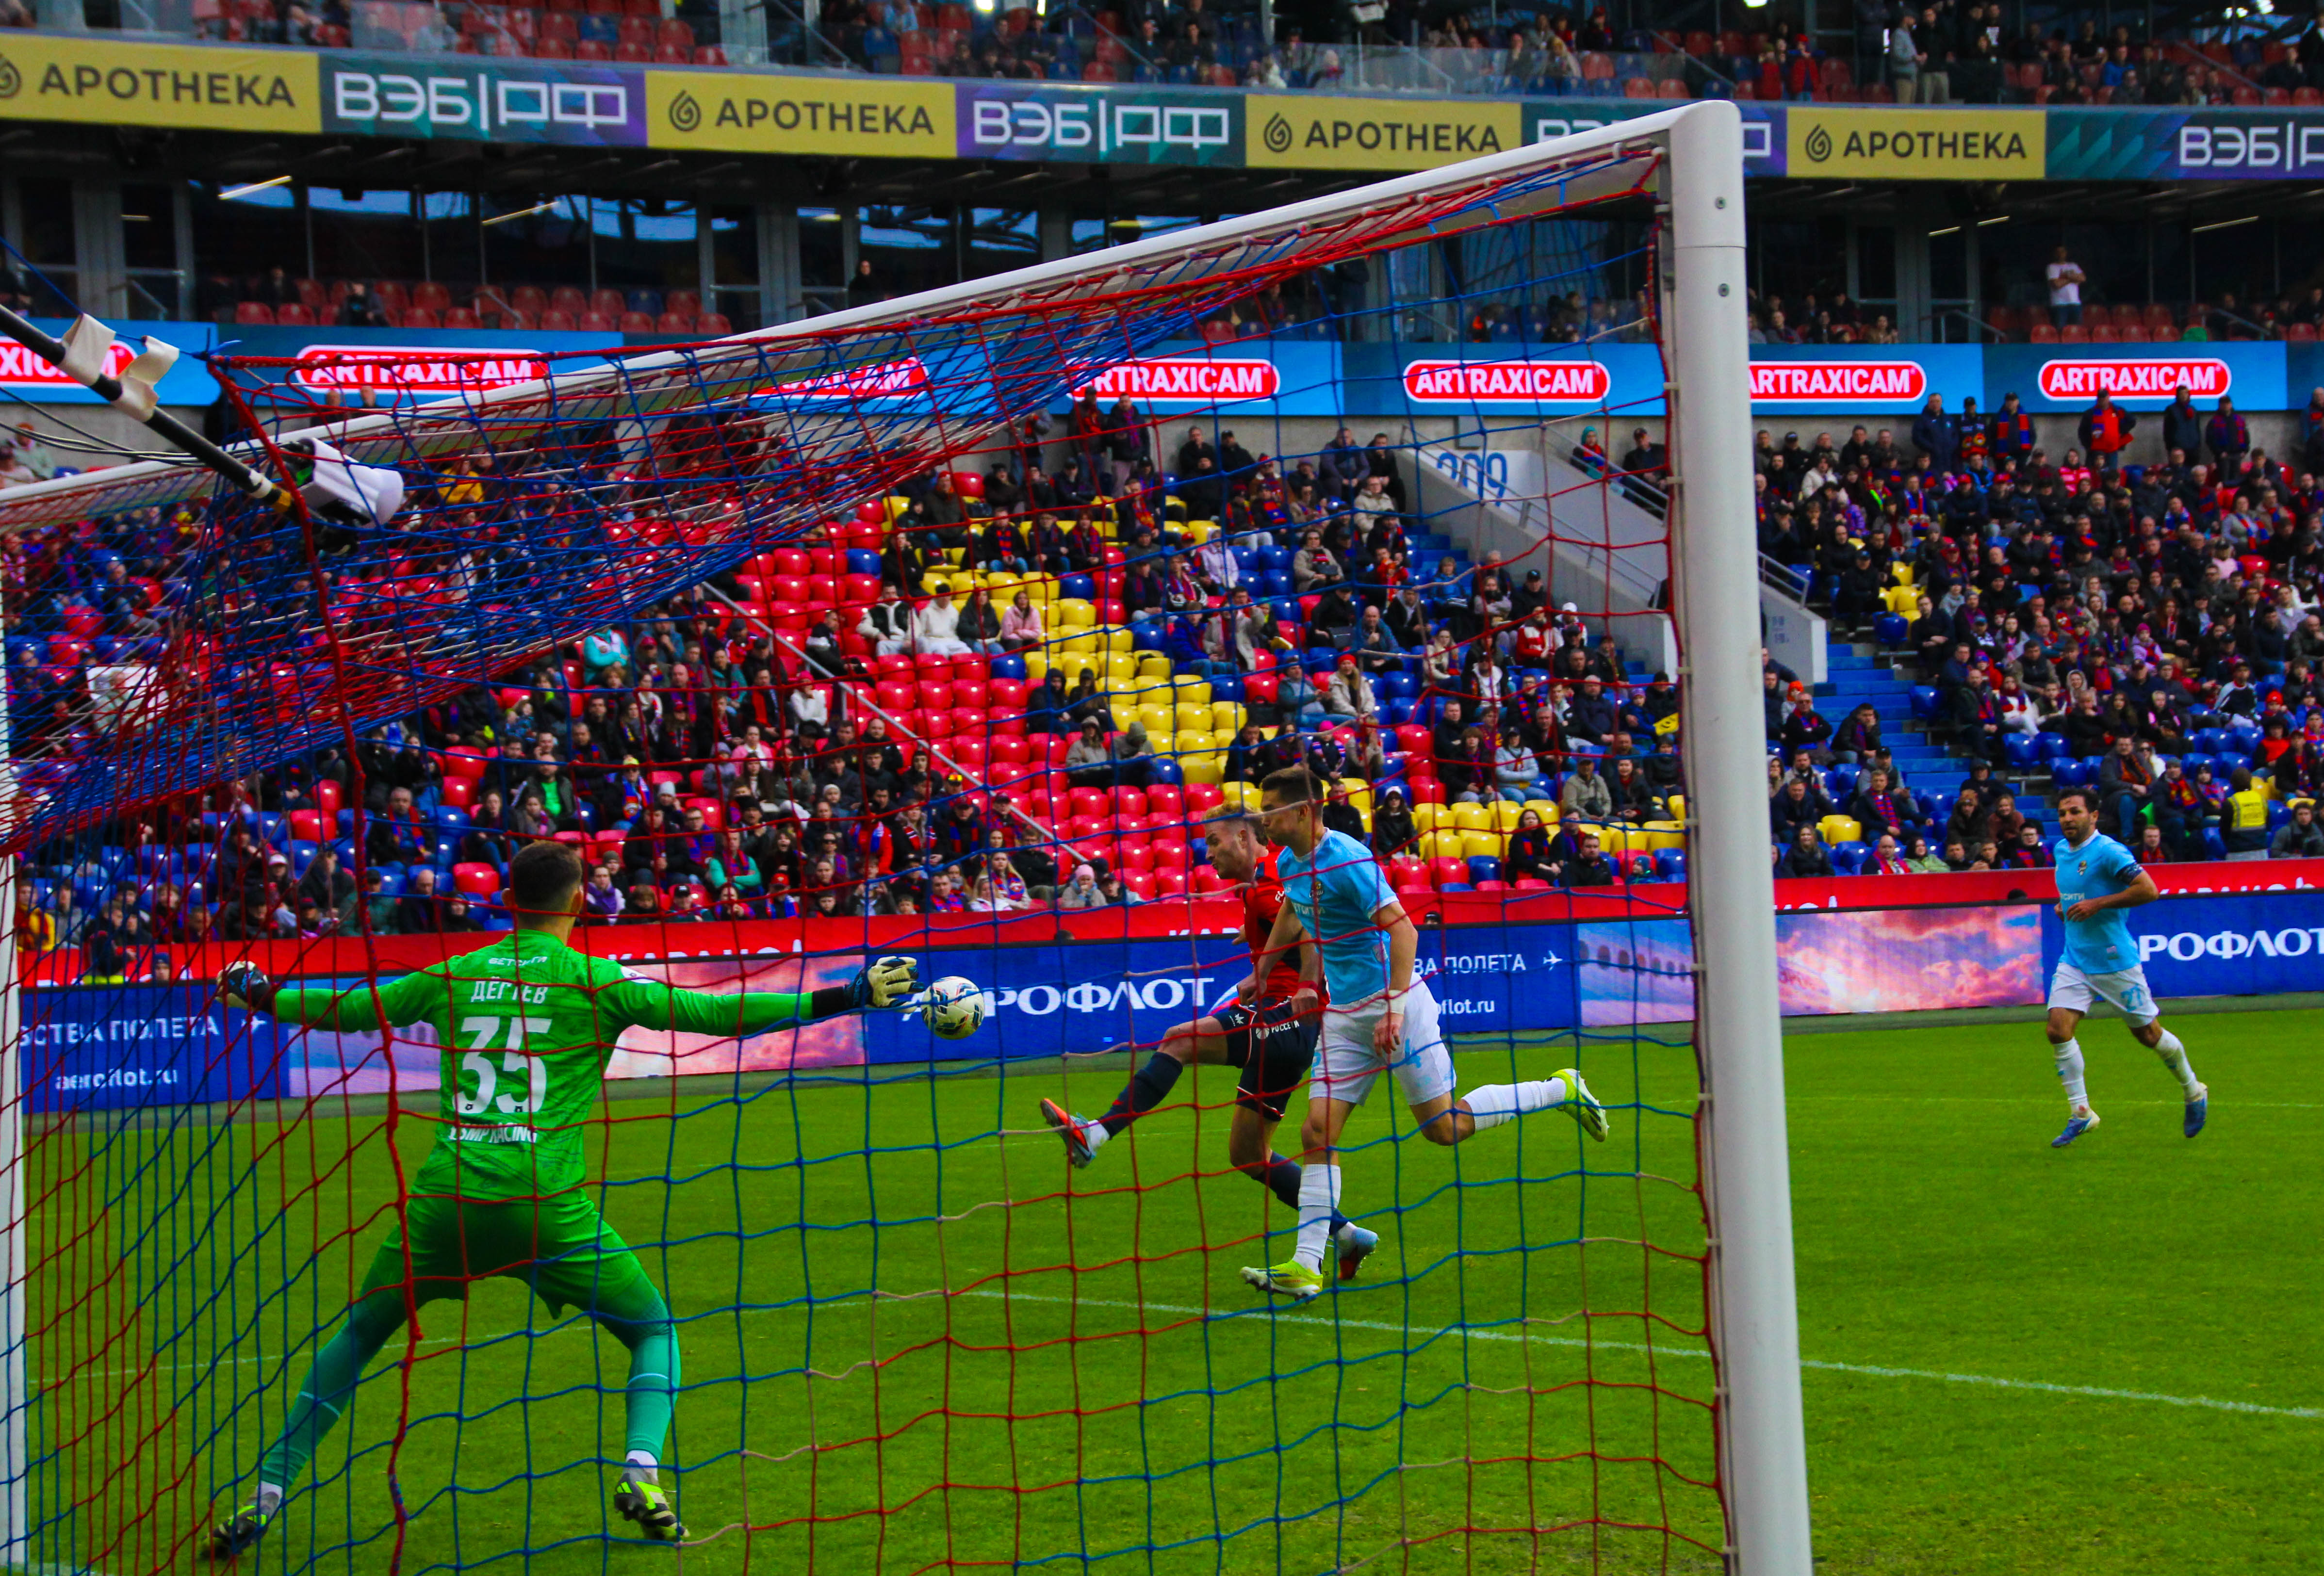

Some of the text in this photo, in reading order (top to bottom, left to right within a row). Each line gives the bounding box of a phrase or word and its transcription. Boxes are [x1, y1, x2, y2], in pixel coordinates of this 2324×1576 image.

[39, 64, 295, 107] APOTHEKA
[716, 98, 934, 135] APOTHEKA
[1305, 120, 1502, 152] APOTHEKA
[1843, 131, 2027, 159] APOTHEKA
[1074, 366, 1263, 392] RTRAXICAM
[1415, 368, 1594, 394] ARTRAXICAM
[2049, 366, 2215, 391] ARTRAXICAM
[2135, 927, 2324, 962] РОФЛОТ
[1444, 953, 1526, 972] ПОЛЕТА
[901, 977, 1215, 1022] РОФЛОТ
[452, 1016, 553, 1114] 35
